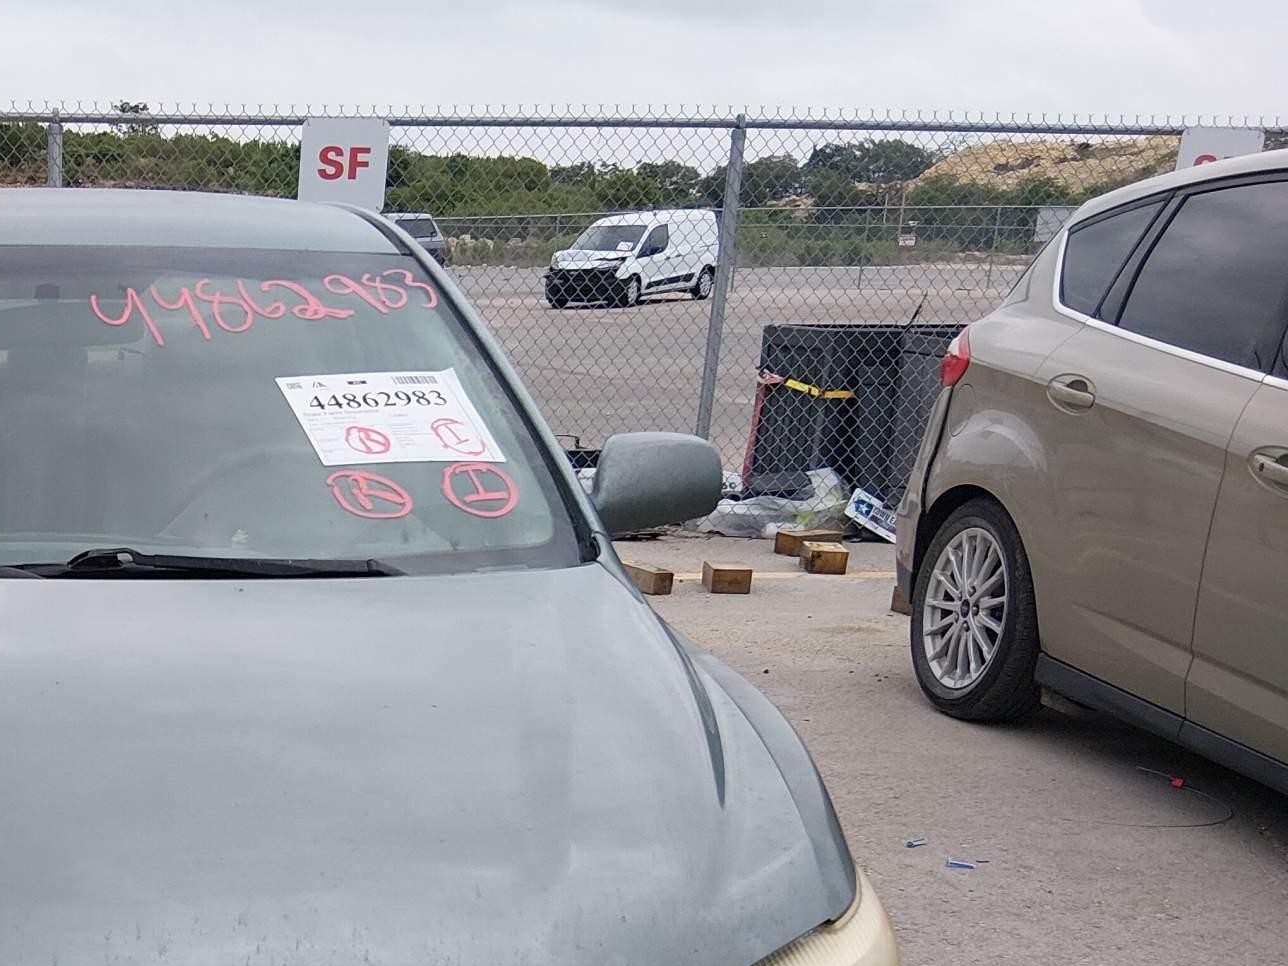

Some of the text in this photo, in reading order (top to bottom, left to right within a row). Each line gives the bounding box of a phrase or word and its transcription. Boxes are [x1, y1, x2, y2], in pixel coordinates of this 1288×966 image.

[317, 146, 371, 180] SF
[90, 269, 439, 347] 44862983
[309, 390, 447, 410] 44862983
